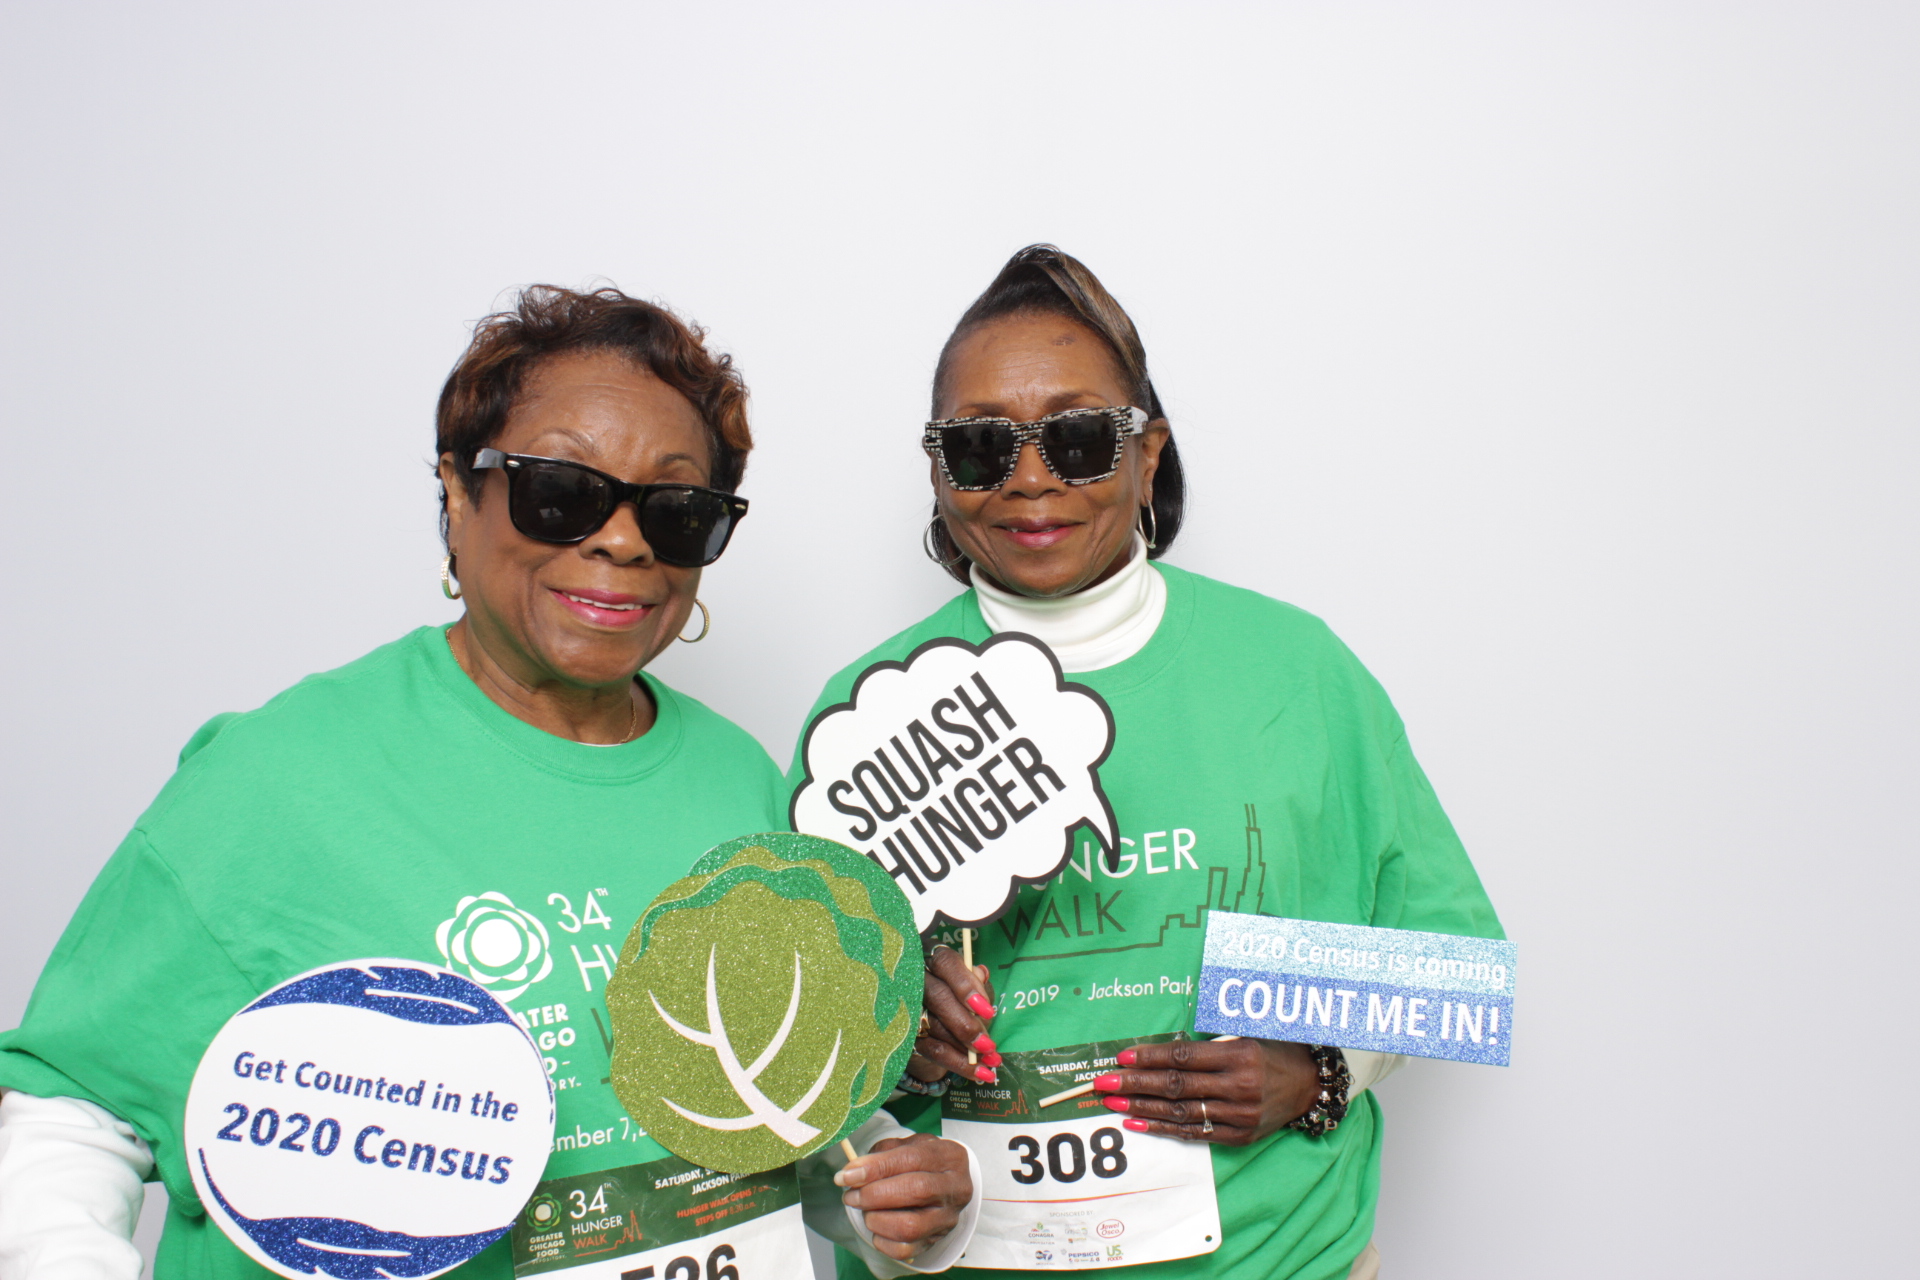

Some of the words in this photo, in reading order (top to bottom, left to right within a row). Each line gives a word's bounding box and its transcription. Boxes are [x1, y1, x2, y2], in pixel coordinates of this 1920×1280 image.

[827, 671, 1017, 841] SQUASH
[866, 737, 1067, 895] HUNGER
[1030, 828, 1199, 891] NGER
[1222, 931, 1286, 960] 2020
[1294, 938, 1379, 970] Census
[1388, 948, 1407, 972] is
[1414, 952, 1508, 989] coming
[1014, 985, 1060, 1009] 2019
[1087, 978, 1152, 1001] Jackson
[1160, 975, 1194, 996] Park
[1217, 978, 1357, 1029] COUNT
[1366, 993, 1428, 1037] ME
[1441, 1001, 1500, 1045] IN!
[1039, 1060, 1090, 1075] SATURDAY,
[233, 1051, 287, 1084] Get
[295, 1061, 426, 1108] Counted
[431, 1083, 462, 1114] in
[470, 1091, 519, 1122] the
[975, 1089, 1012, 1100] HUNGER
[977, 1100, 1000, 1111] WALK
[1077, 1100, 1099, 1109] STEPS
[216, 1102, 342, 1157] 2020
[354, 1125, 514, 1185] Census
[1008, 1127, 1128, 1185] 308
[655, 1169, 704, 1190] SATURDAY,
[691, 1175, 730, 1195] JACKSON
[676, 1203, 709, 1218] HUNGER
[709, 1197, 730, 1209] WALK
[730, 1188, 752, 1202] OPENS
[572, 1215, 623, 1236] HUNGER
[695, 1213, 715, 1226] STEPS
[715, 1208, 729, 1219] OFF
[529, 1232, 564, 1244] GREATER
[573, 1233, 608, 1249] WALK
[1101, 1228, 1120, 1236] Osco
[529, 1239, 566, 1252] CHICAGO
[536, 1249, 559, 1258] FOOD
